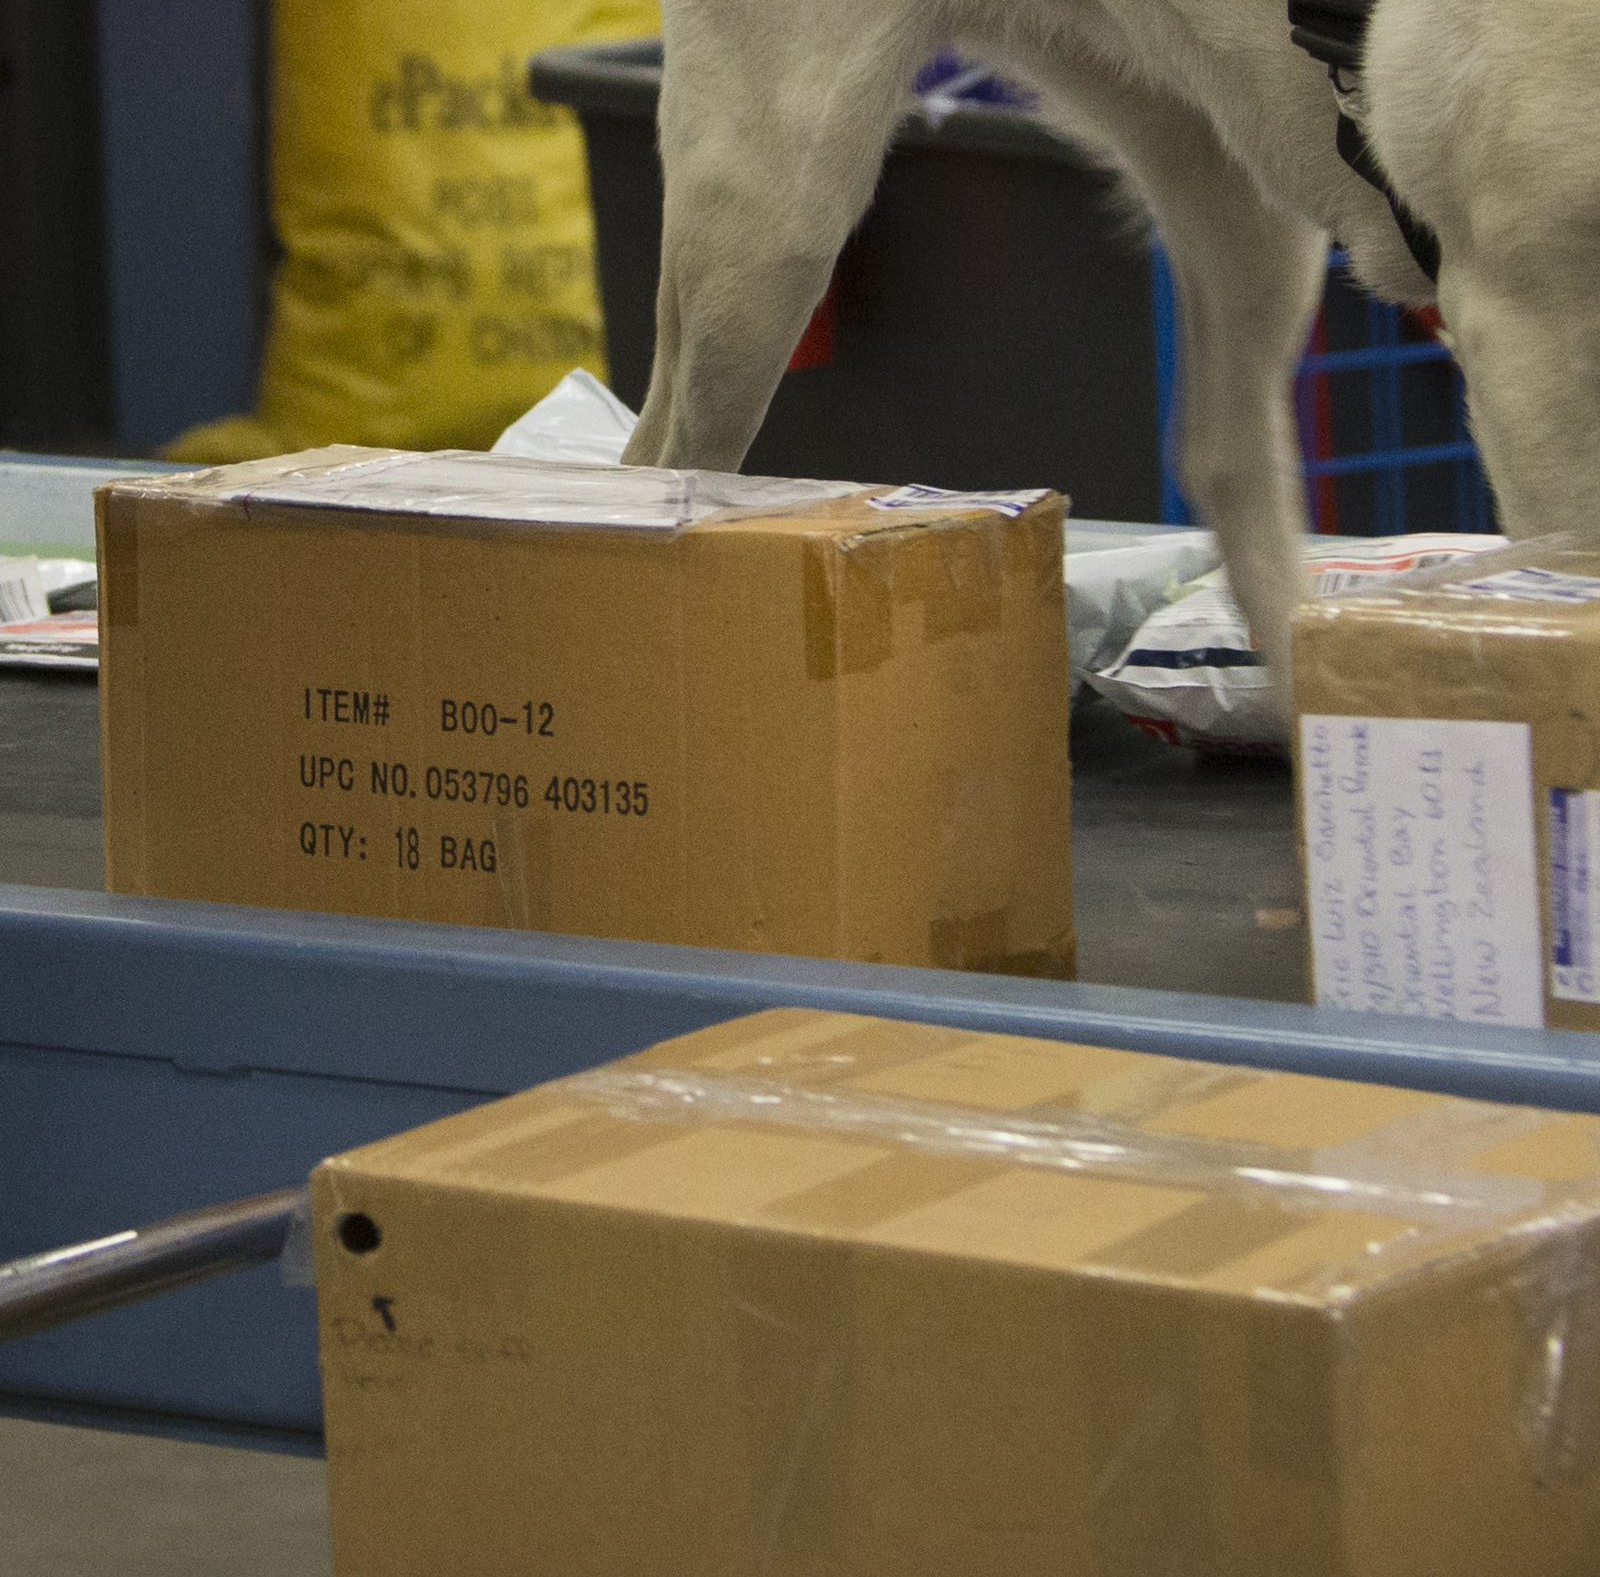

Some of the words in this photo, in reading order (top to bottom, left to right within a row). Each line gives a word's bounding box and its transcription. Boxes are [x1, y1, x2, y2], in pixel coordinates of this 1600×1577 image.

[303, 687, 391, 727] ITEM#
[298, 754, 355, 792] UPC
[544, 775, 650, 817] 403135
[299, 822, 368, 862] QTY:
[394, 826, 420, 871] 18
[439, 834, 498, 874] BAG
[1389, 806, 1415, 867] Bay
[1461, 761, 1496, 921] Zealand
[1466, 939, 1504, 1018] New
